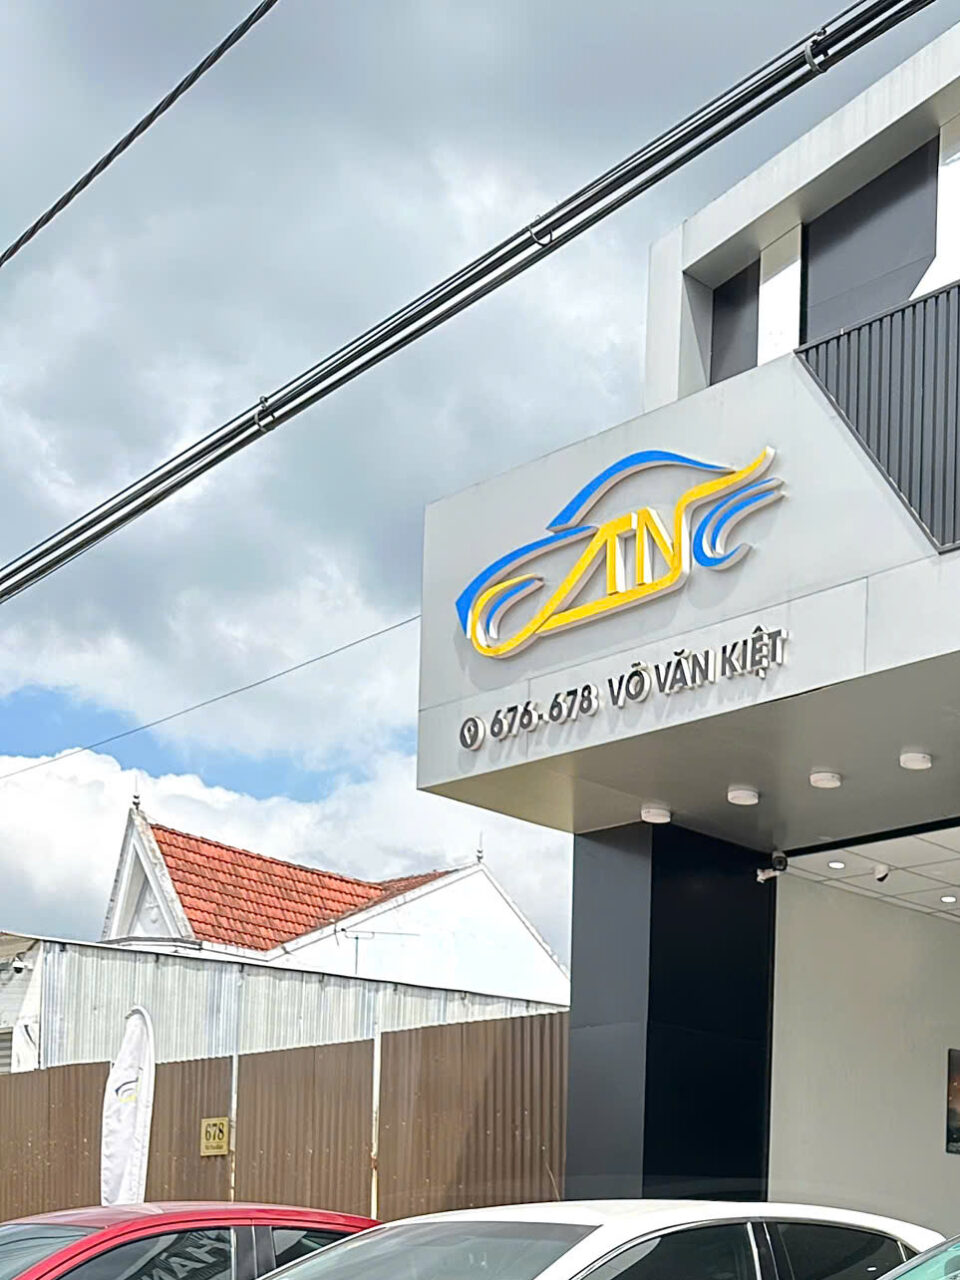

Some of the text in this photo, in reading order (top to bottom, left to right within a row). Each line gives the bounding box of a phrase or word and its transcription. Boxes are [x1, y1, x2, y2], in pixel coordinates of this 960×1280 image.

[608, 661, 651, 708] VÕ
[654, 647, 715, 694] VĂN
[721, 625, 788, 679] KIỆT
[205, 1122, 225, 1141] 678
